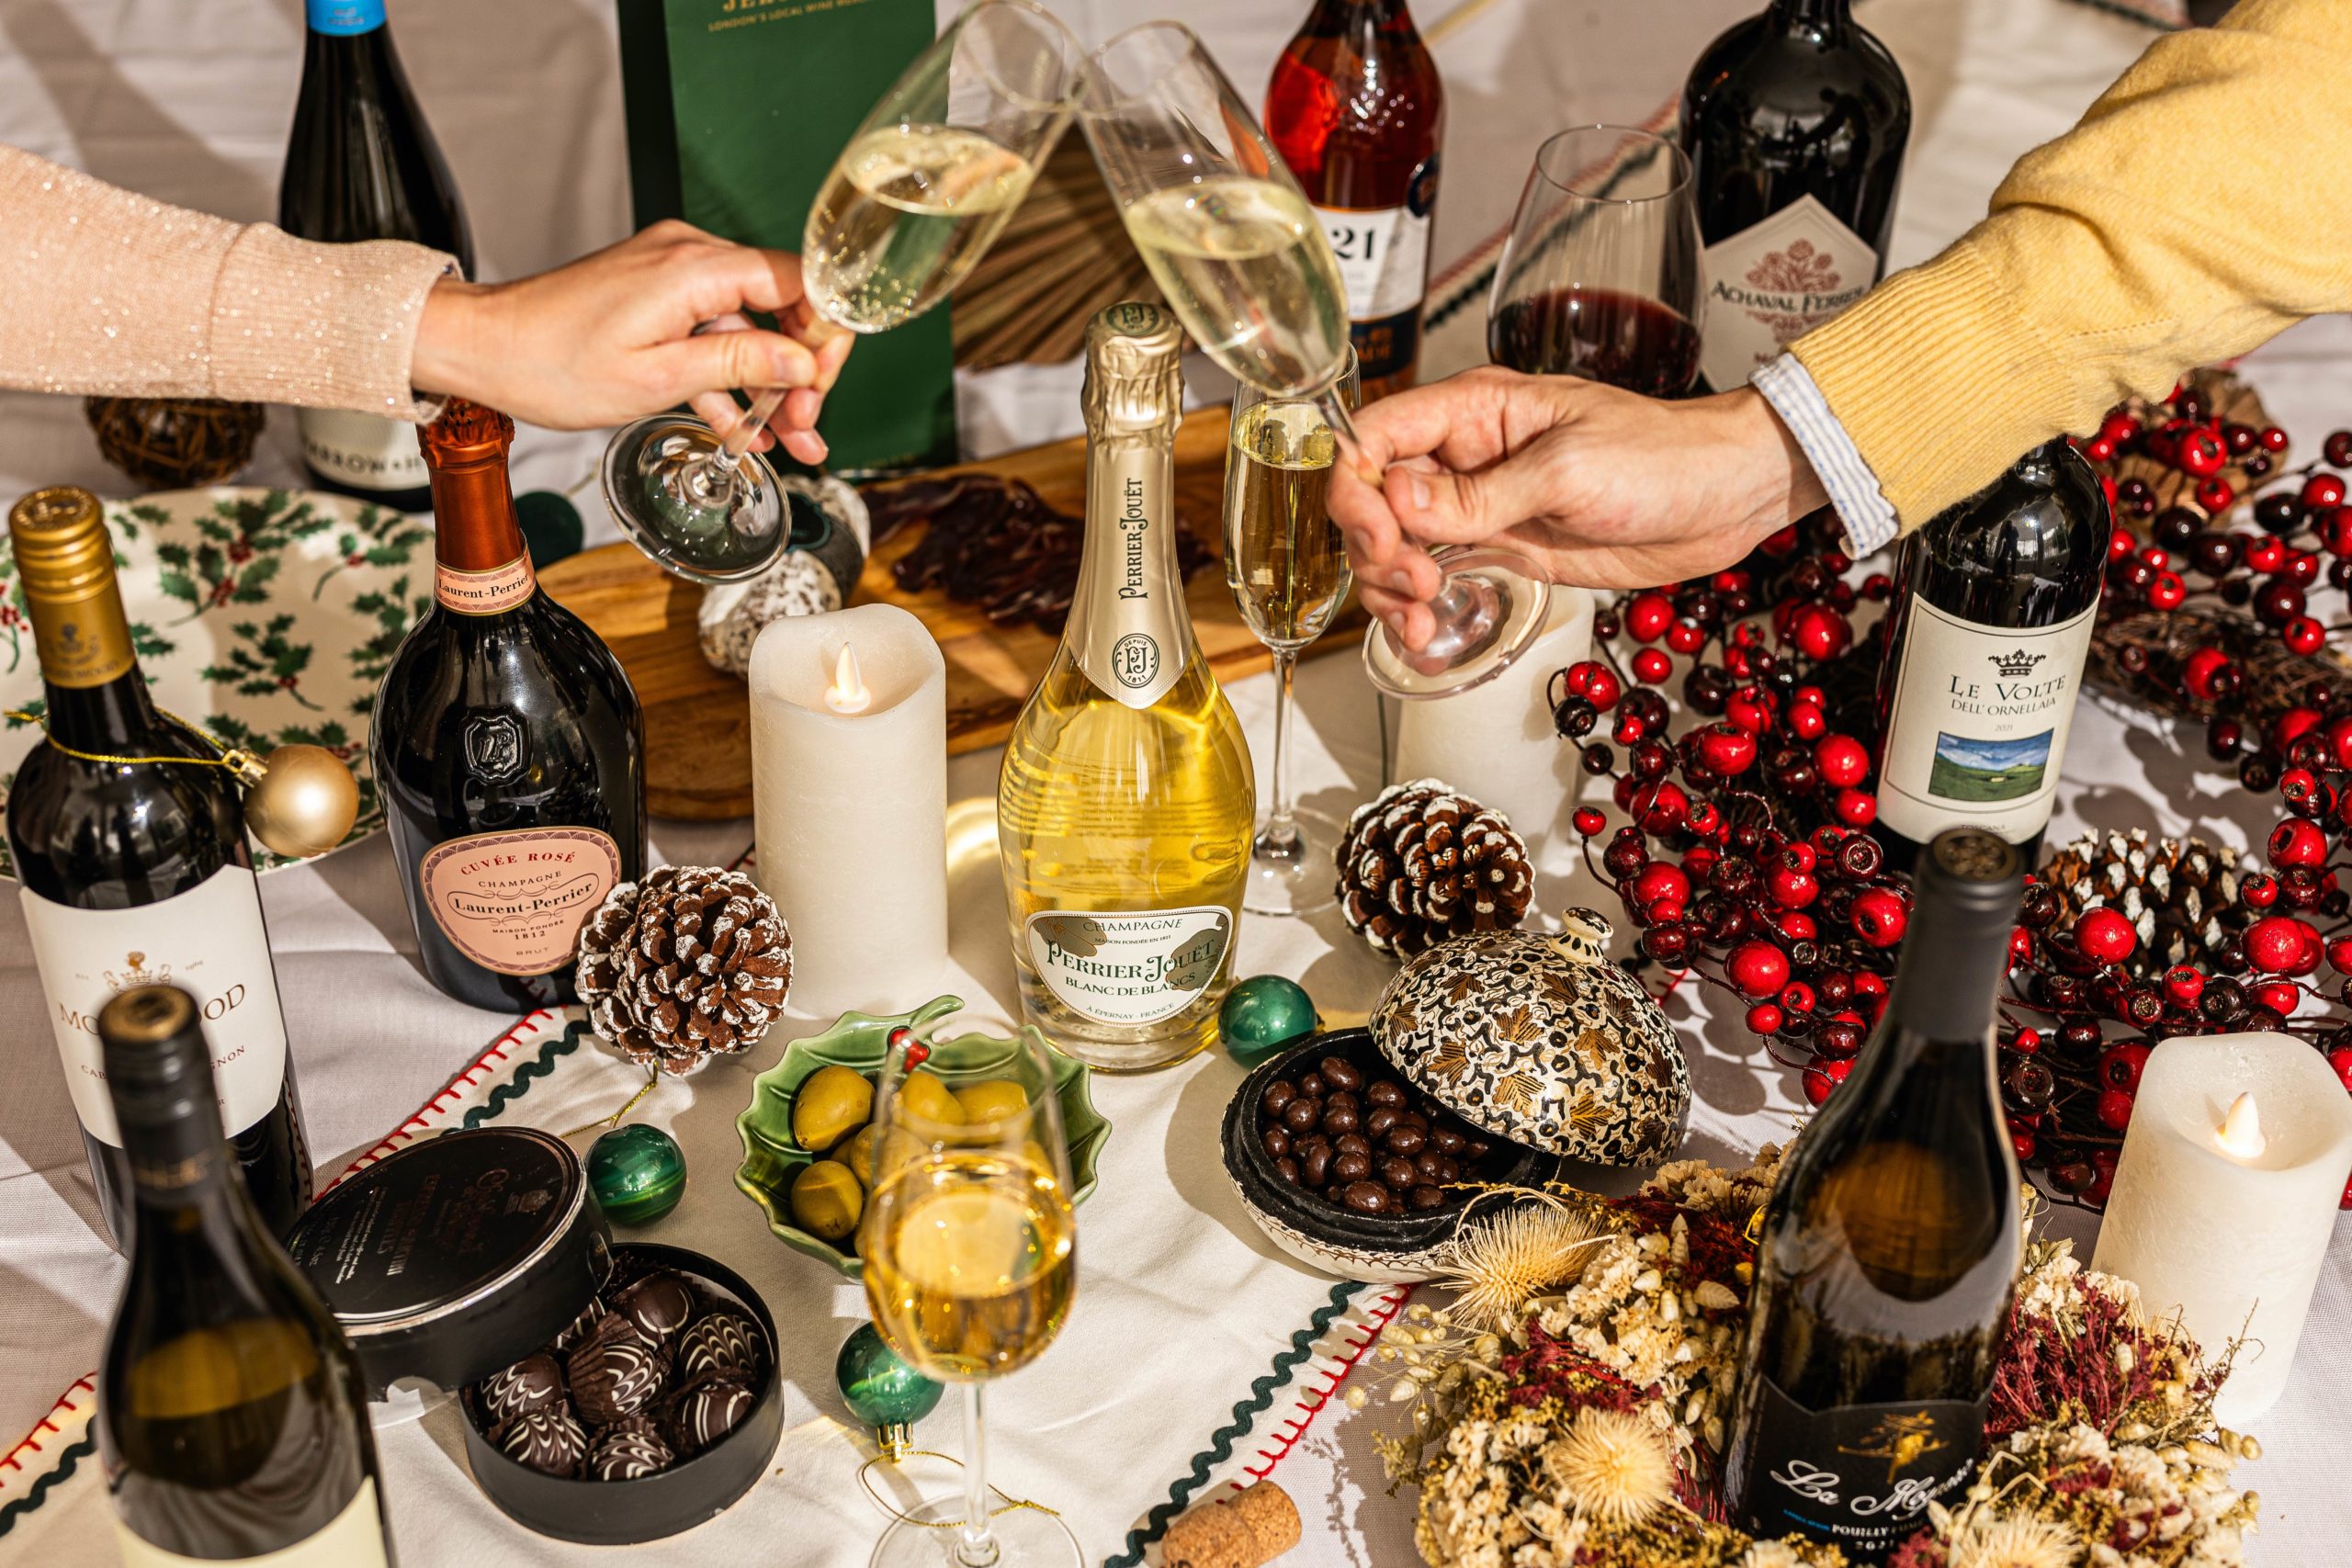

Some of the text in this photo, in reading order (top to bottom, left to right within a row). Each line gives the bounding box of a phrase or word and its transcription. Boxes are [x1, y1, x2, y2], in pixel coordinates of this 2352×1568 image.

[1331, 225, 1375, 260] 21
[1712, 279, 1797, 312] ACHAVAL
[1119, 478, 1148, 600] PERRIER-JOUËT
[438, 573, 529, 598] Laurent-Perrier
[1124, 638, 1148, 648] DEPUIS
[1127, 674, 1147, 682] 1811
[1948, 674, 2066, 701] LE VOLTE
[460, 852, 575, 875] CUVÉE ROSÉ
[479, 871, 562, 888] CHAMPAGNE
[455, 883, 592, 914] Laurent-Perrier
[515, 931, 546, 941] 1812
[1082, 919, 1183, 932] CHAMPAGNE
[516, 947, 549, 956] BRUT
[1065, 972, 1196, 997] BLANC DE BLANCS
[1140, 1002, 1175, 1018] FRANCE
[1770, 1460, 1840, 1506] La
[1831, 1524, 1889, 1538] POUILLY
